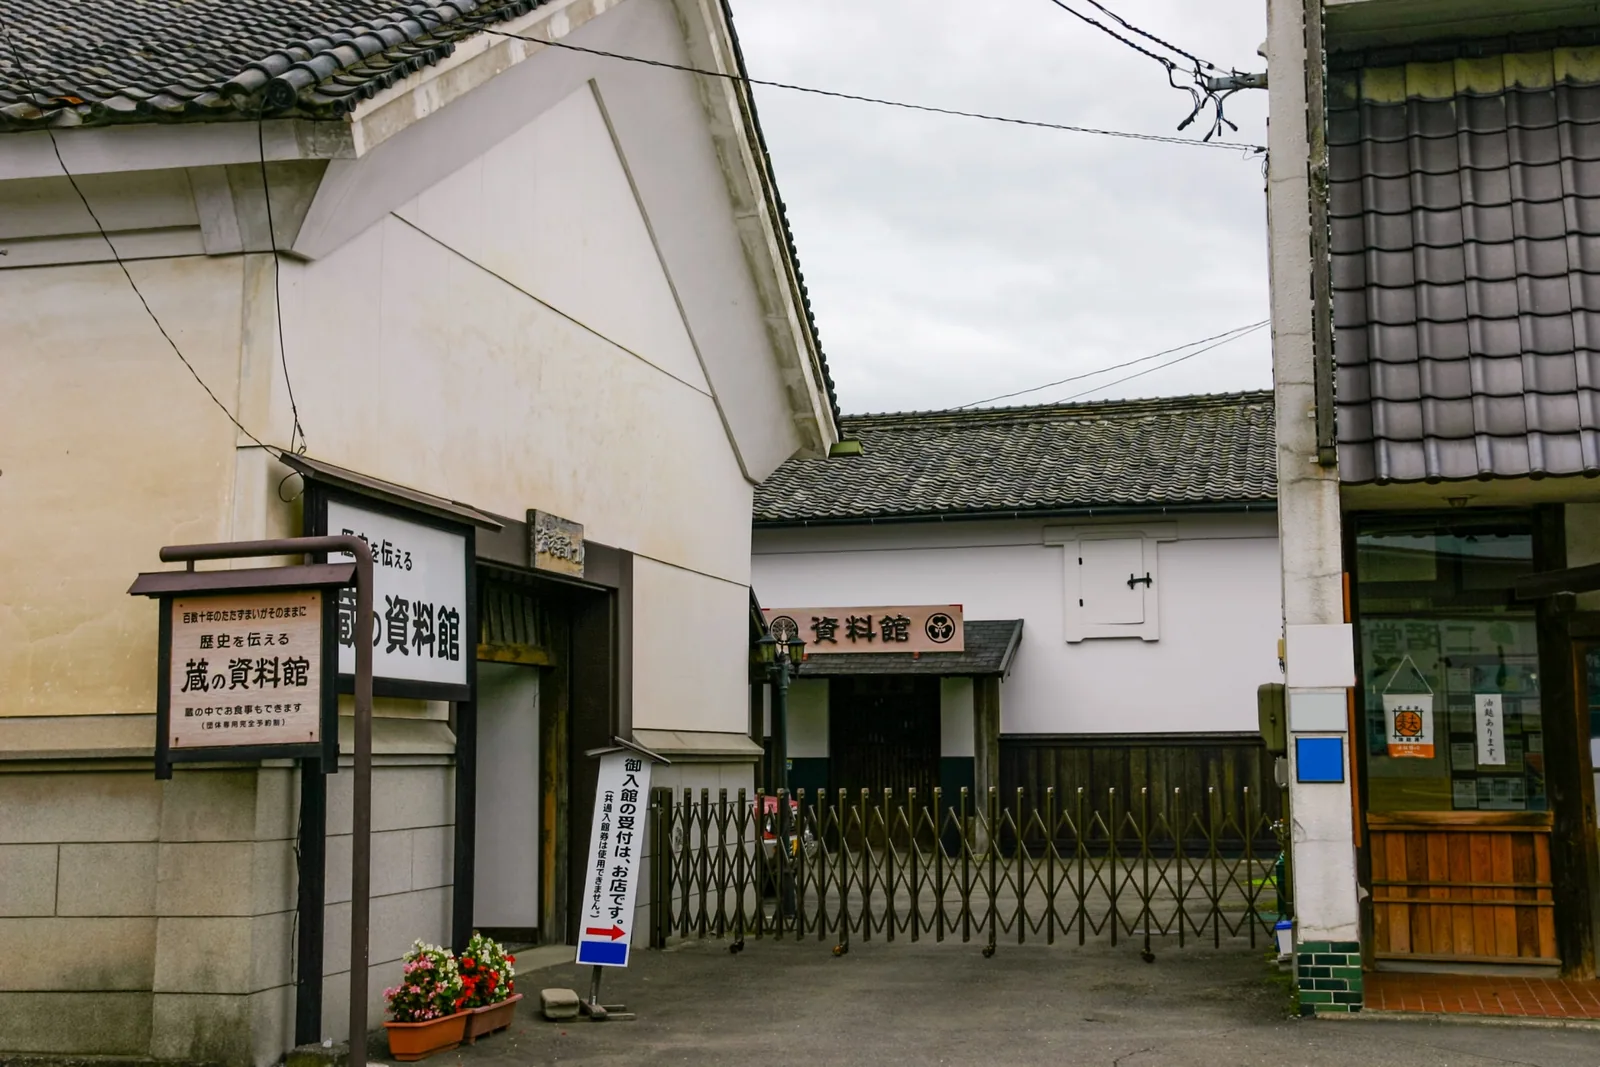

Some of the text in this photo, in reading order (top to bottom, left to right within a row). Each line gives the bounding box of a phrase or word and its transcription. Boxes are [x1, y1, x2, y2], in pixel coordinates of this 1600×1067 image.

[183, 606, 307, 624] 百数十年のたたずまいがそのままに
[200, 631, 290, 649] 歴史を伝える
[810, 613, 911, 644] 資料館
[180, 655, 310, 693] 蔵の資料館
[184, 702, 302, 717] 蔵の中でお食事もできます
[608, 758, 642, 925] 御入館の受付は、お店です。
